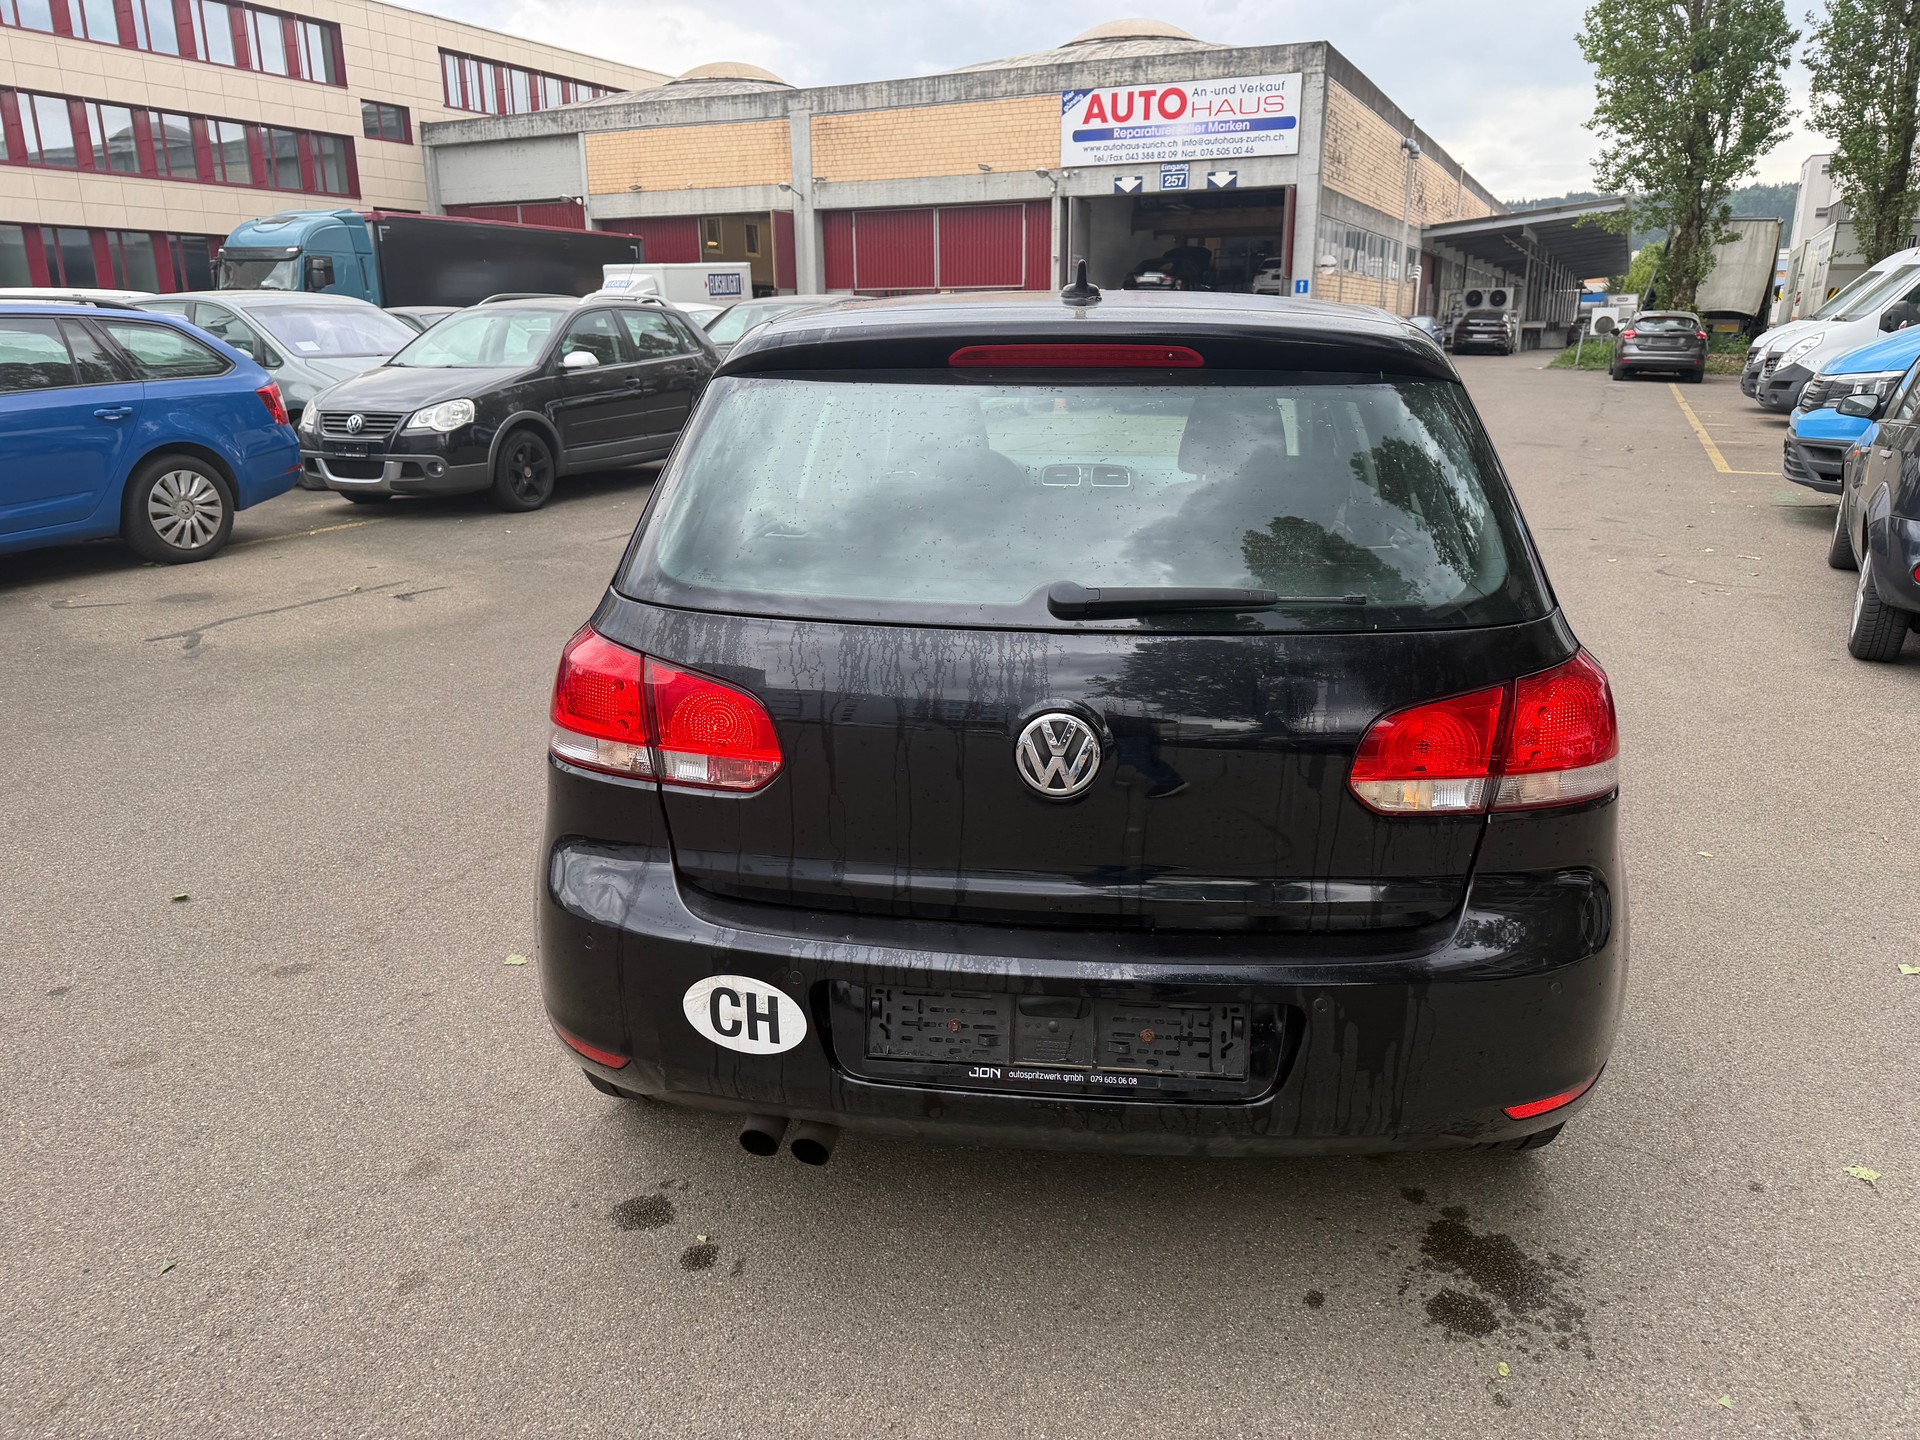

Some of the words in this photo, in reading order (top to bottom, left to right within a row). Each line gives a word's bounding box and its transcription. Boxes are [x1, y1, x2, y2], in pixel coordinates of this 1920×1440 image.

[1192, 87, 1207, 97] An
[1240, 80, 1285, 94] Verkauf
[1082, 87, 1187, 125] AUTO
[1191, 95, 1285, 118] HAUS
[1208, 121, 1250, 133] Marken
[1083, 139, 1178, 152] www.autohaus-zurich.ch
[1181, 133, 1285, 147] info@autohaus-zurich.ch
[1093, 154, 1123, 163] Tel./Fax
[1125, 152, 1139, 161] 043
[1141, 151, 1155, 160] 388
[1156, 151, 1166, 159] 82
[1168, 150, 1178, 158] 09
[1200, 148, 1214, 157] 076
[1216, 147, 1231, 156] 505
[1232, 146, 1242, 155] 00
[1244, 146, 1254, 154] 46
[1161, 164, 1189, 172] Eingang
[1165, 175, 1185, 187] 257
[709, 986, 780, 1044] CH
[968, 1067, 1001, 1079] JON
[1008, 1070, 1062, 1082] autospritzwerk
[1062, 1072, 1084, 1083] gmbh
[1090, 1075, 1103, 1084] 079
[1104, 1076, 1117, 1085] 605
[1118, 1076, 1127, 1085] 06
[1128, 1077, 1138, 1085] 08
